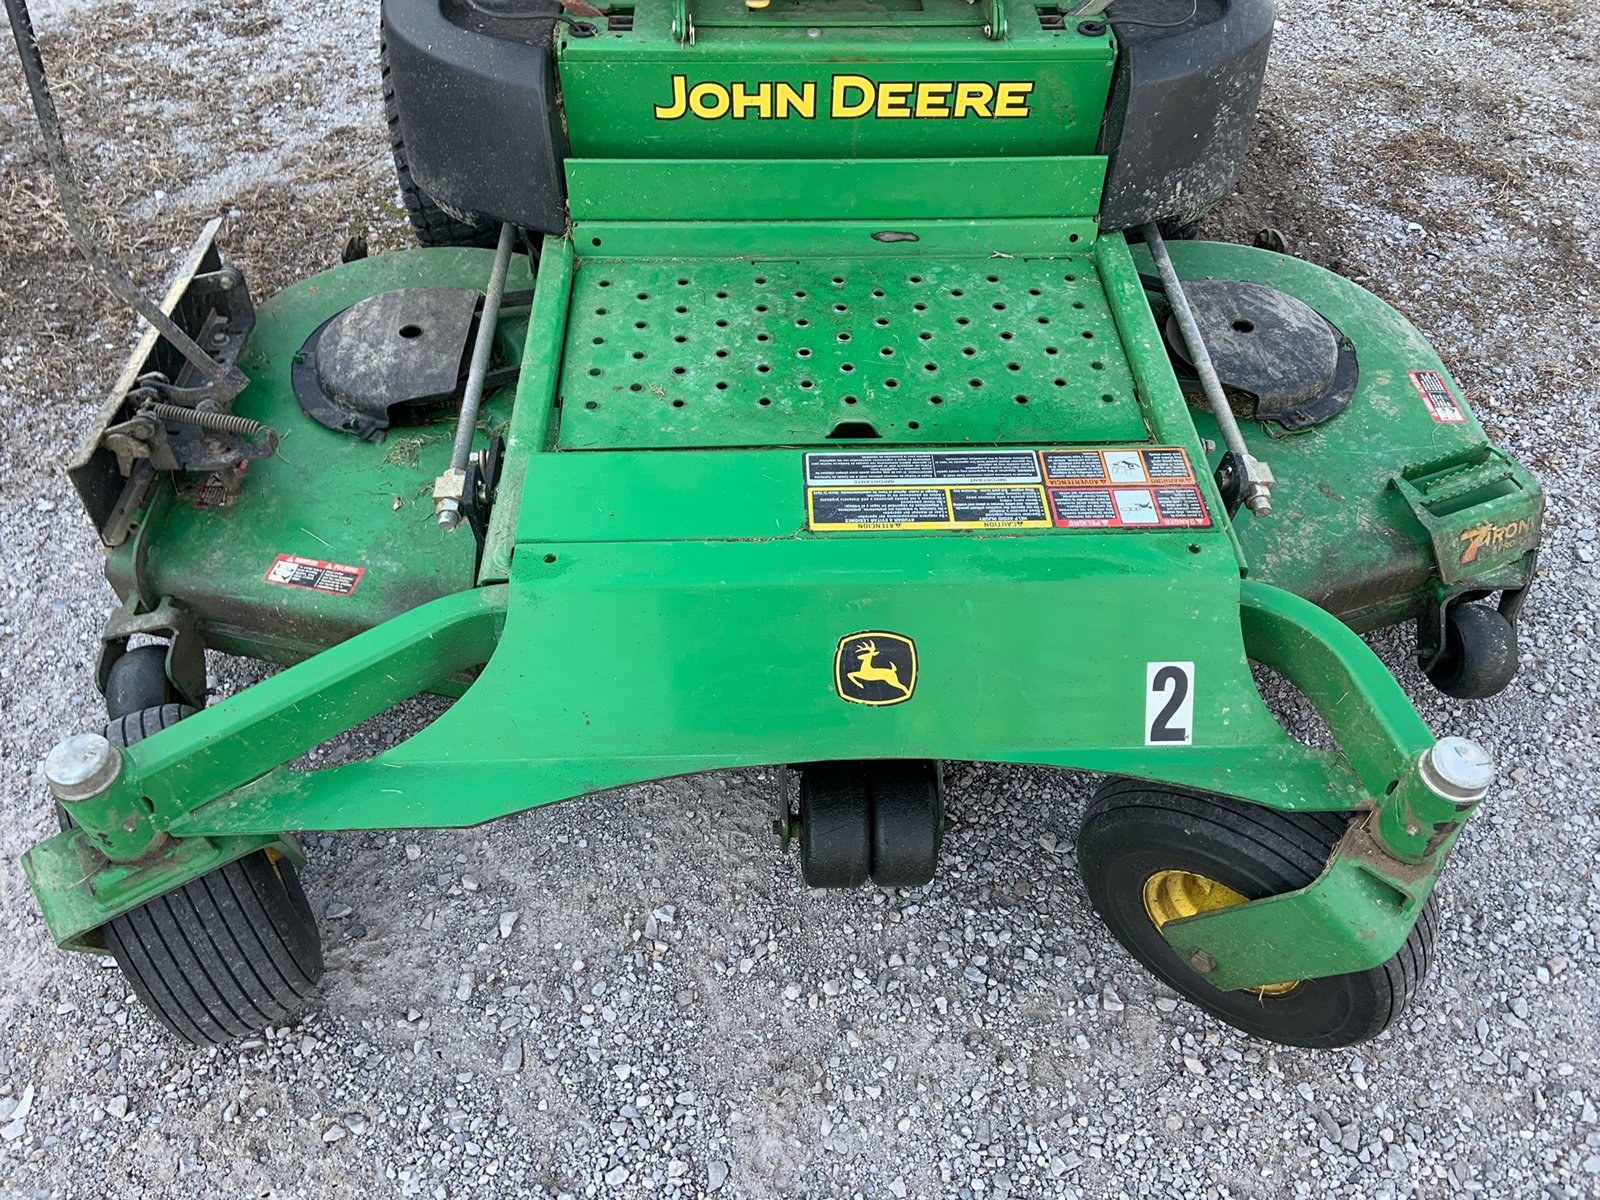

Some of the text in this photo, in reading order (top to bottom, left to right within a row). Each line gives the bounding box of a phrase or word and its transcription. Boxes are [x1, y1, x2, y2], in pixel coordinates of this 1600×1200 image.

[653, 73, 1035, 120] JOHN DEERE
[1150, 664, 1188, 742] 2
